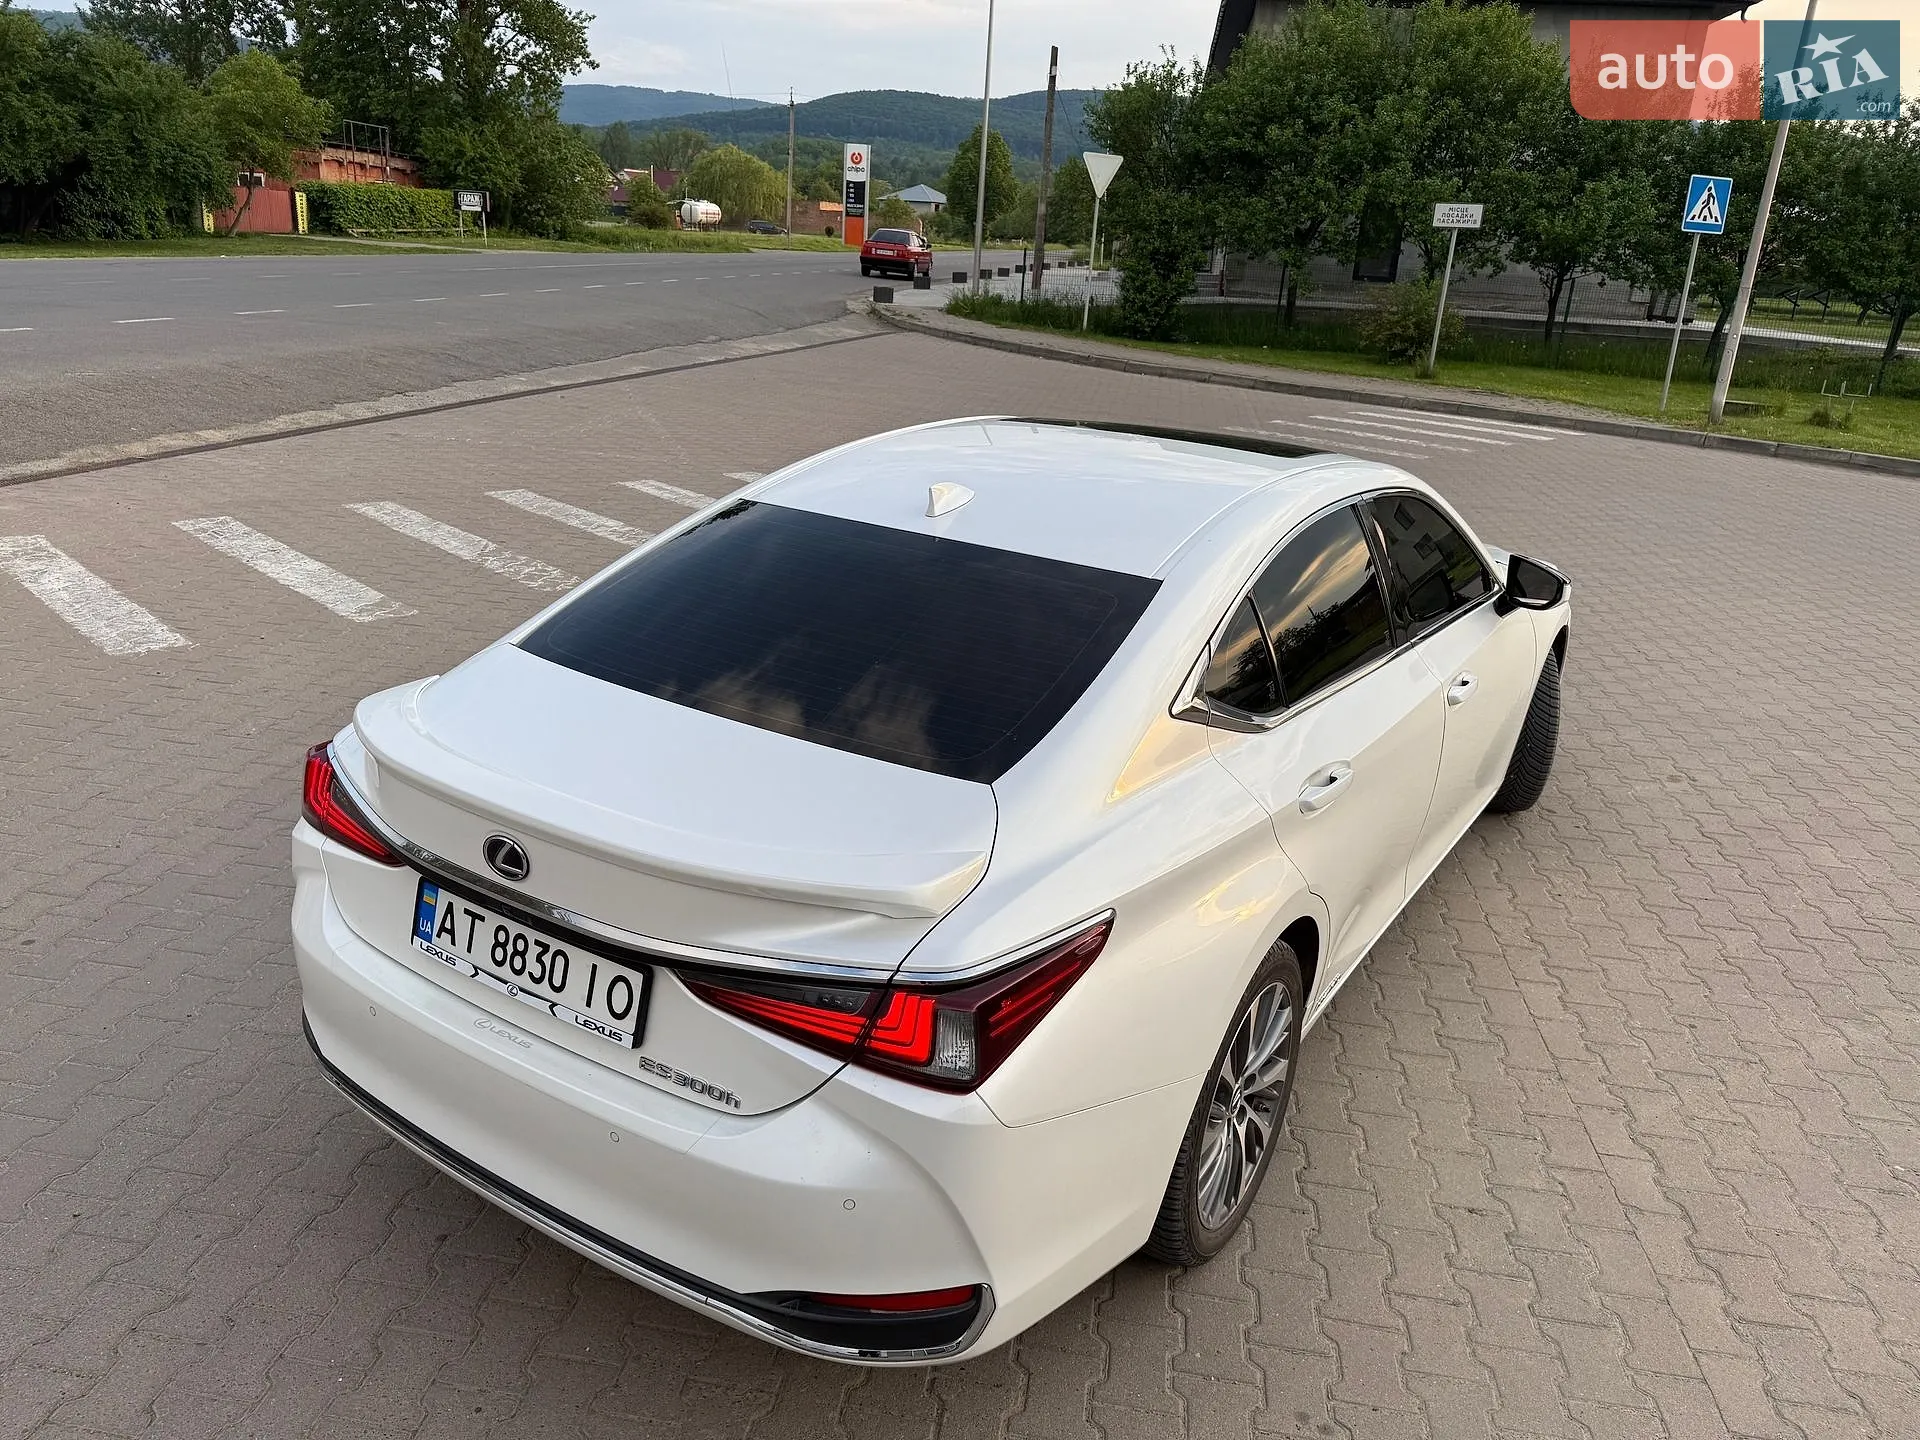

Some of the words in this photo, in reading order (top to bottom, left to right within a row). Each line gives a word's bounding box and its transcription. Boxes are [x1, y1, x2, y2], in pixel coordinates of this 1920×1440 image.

[419, 917, 432, 934] UA
[419, 943, 457, 967] LEXUS
[436, 900, 485, 954] AT
[490, 924, 570, 994] 8830
[585, 962, 634, 1021] IO
[489, 1025, 534, 1049] LEXUS
[574, 1015, 623, 1042] LEXUS
[639, 1055, 742, 1109] ES300h
